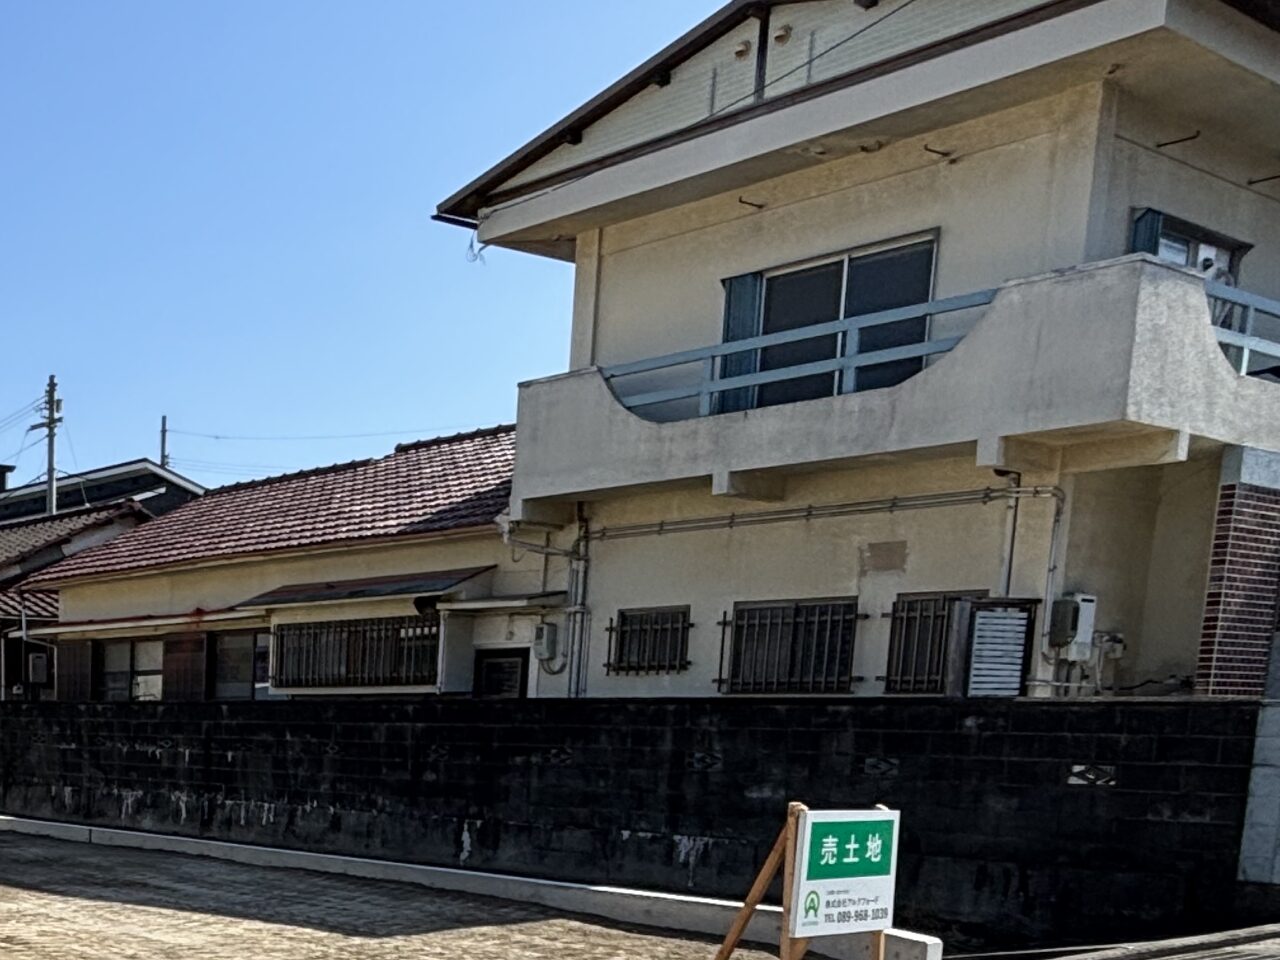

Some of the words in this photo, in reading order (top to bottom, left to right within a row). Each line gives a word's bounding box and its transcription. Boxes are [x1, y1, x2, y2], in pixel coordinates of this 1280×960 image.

[820, 833, 882, 865] 売土地
[825, 913, 835, 923] TEL
